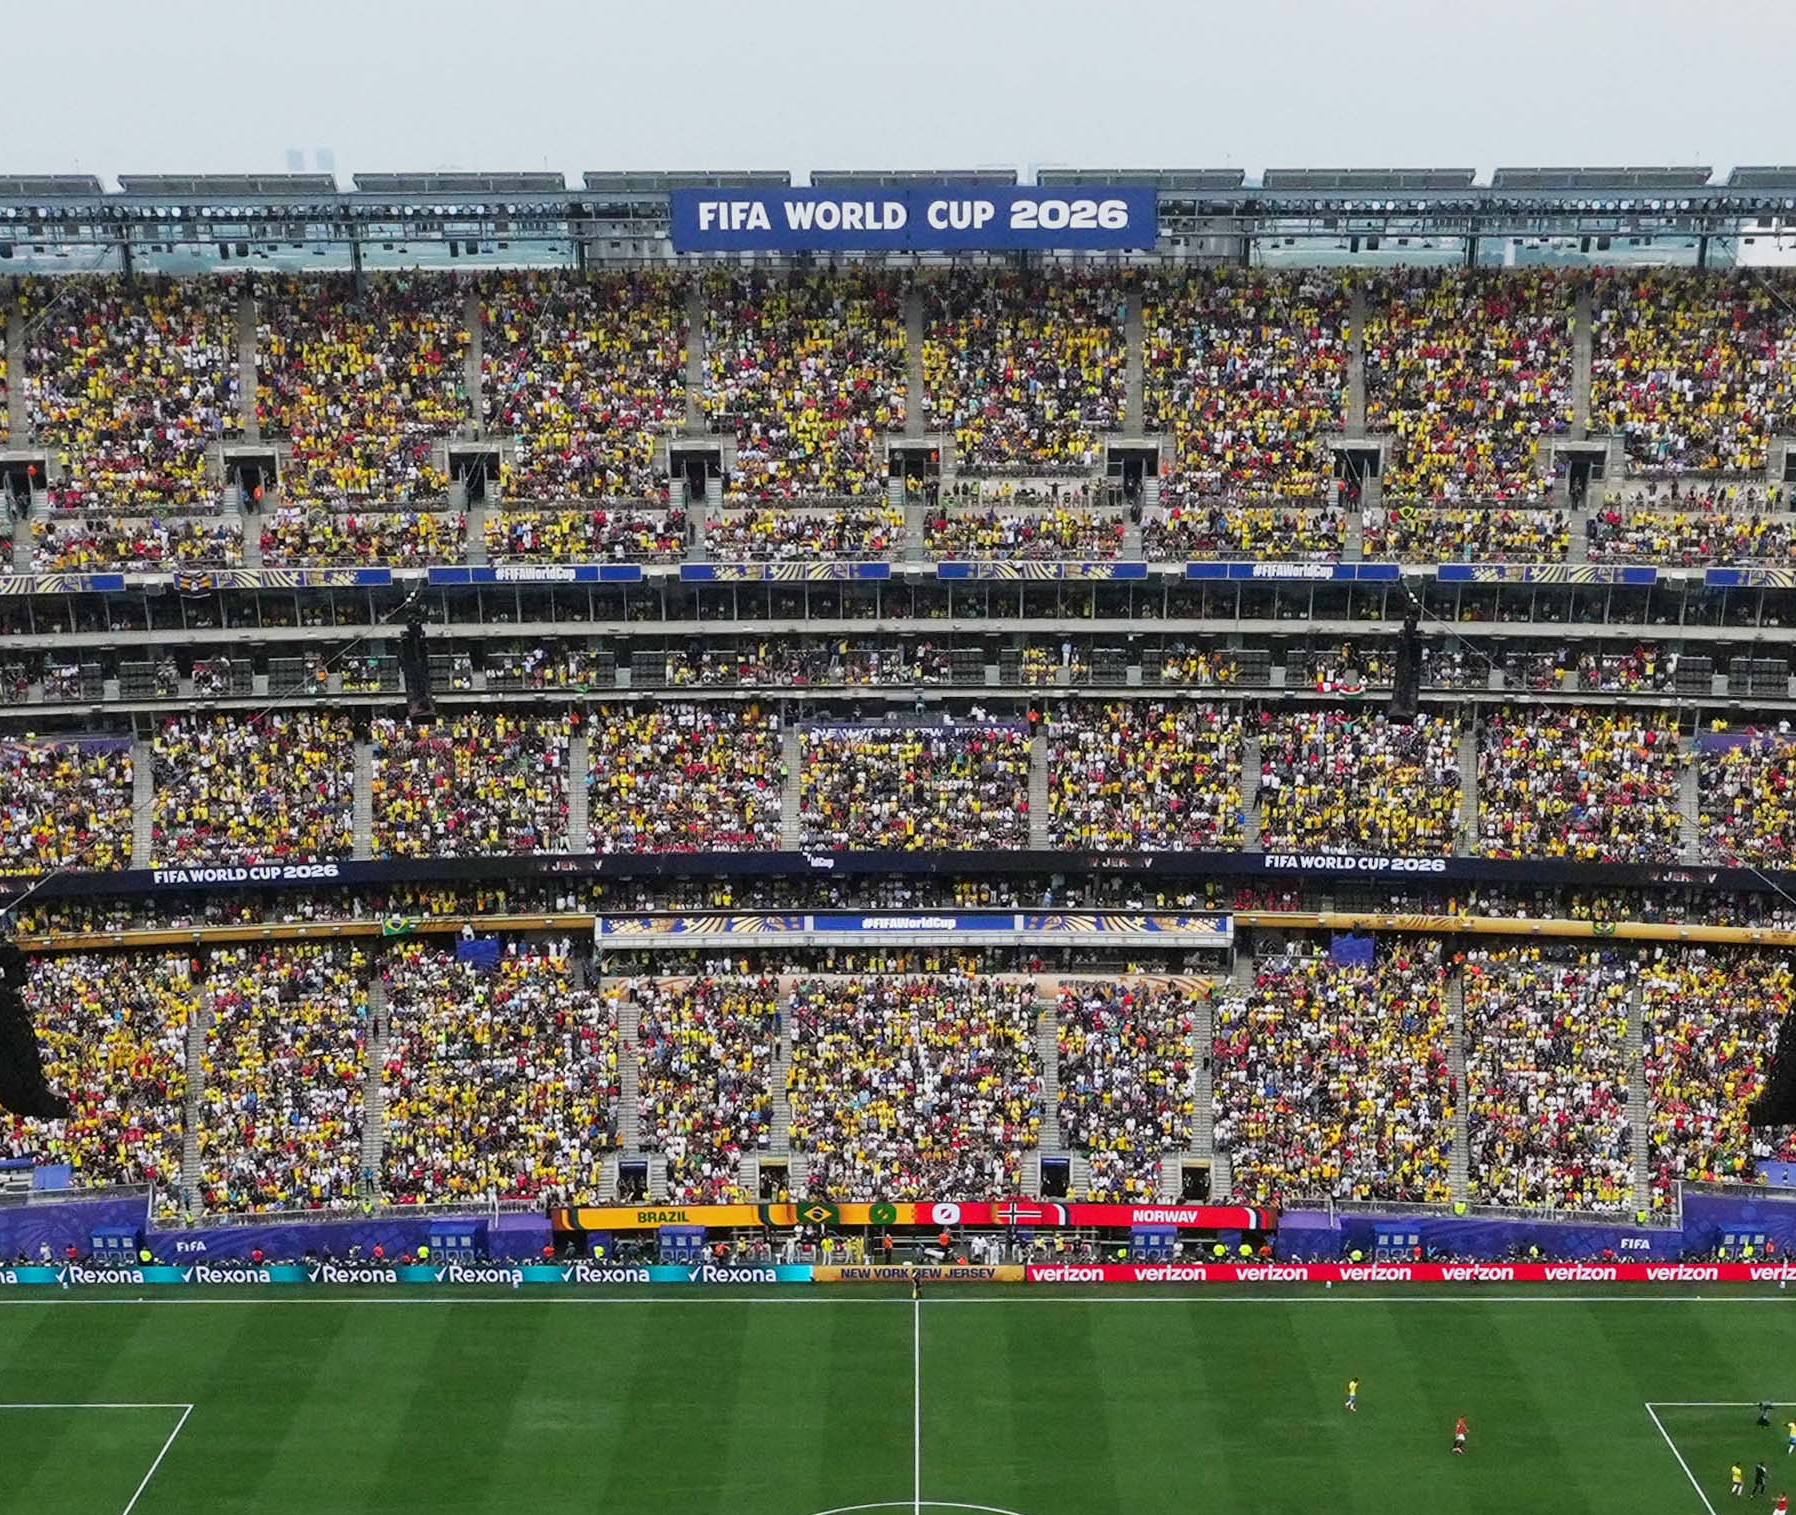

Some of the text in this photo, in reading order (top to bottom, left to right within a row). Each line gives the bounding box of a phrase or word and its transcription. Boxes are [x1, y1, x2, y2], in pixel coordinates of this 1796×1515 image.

[698, 199, 1130, 231] FIFA WORLD CUP 2026
[1264, 854, 1447, 872] FIFA WORLD CUP 2026
[152, 864, 339, 885] FIFA WORLD CUP 2026
[862, 917, 957, 931] #FIFAWorldCup
[637, 1211, 689, 1224] BRAZIL
[1132, 1209, 1198, 1223] NORWAY
[176, 1240, 207, 1253] FIFA
[1620, 1238, 1651, 1250] FIFA
[69, 1266, 144, 1284] Rexona
[196, 1266, 271, 1284] Rexona
[322, 1266, 397, 1283] Rexona
[449, 1266, 523, 1283] Rexona
[576, 1265, 651, 1283] Rexona
[703, 1265, 777, 1283] Rexona
[840, 1269, 872, 1279] NEW
[873, 1268, 909, 1279] YORK
[944, 1268, 995, 1279] JERSEY
[1032, 1264, 1104, 1282] verizon
[1134, 1264, 1207, 1281] verizon
[1236, 1265, 1308, 1281] verizon
[1339, 1265, 1412, 1281] verizon
[1441, 1265, 1515, 1281] verizon
[1544, 1265, 1617, 1281] verizon
[1646, 1264, 1719, 1281] verizon
